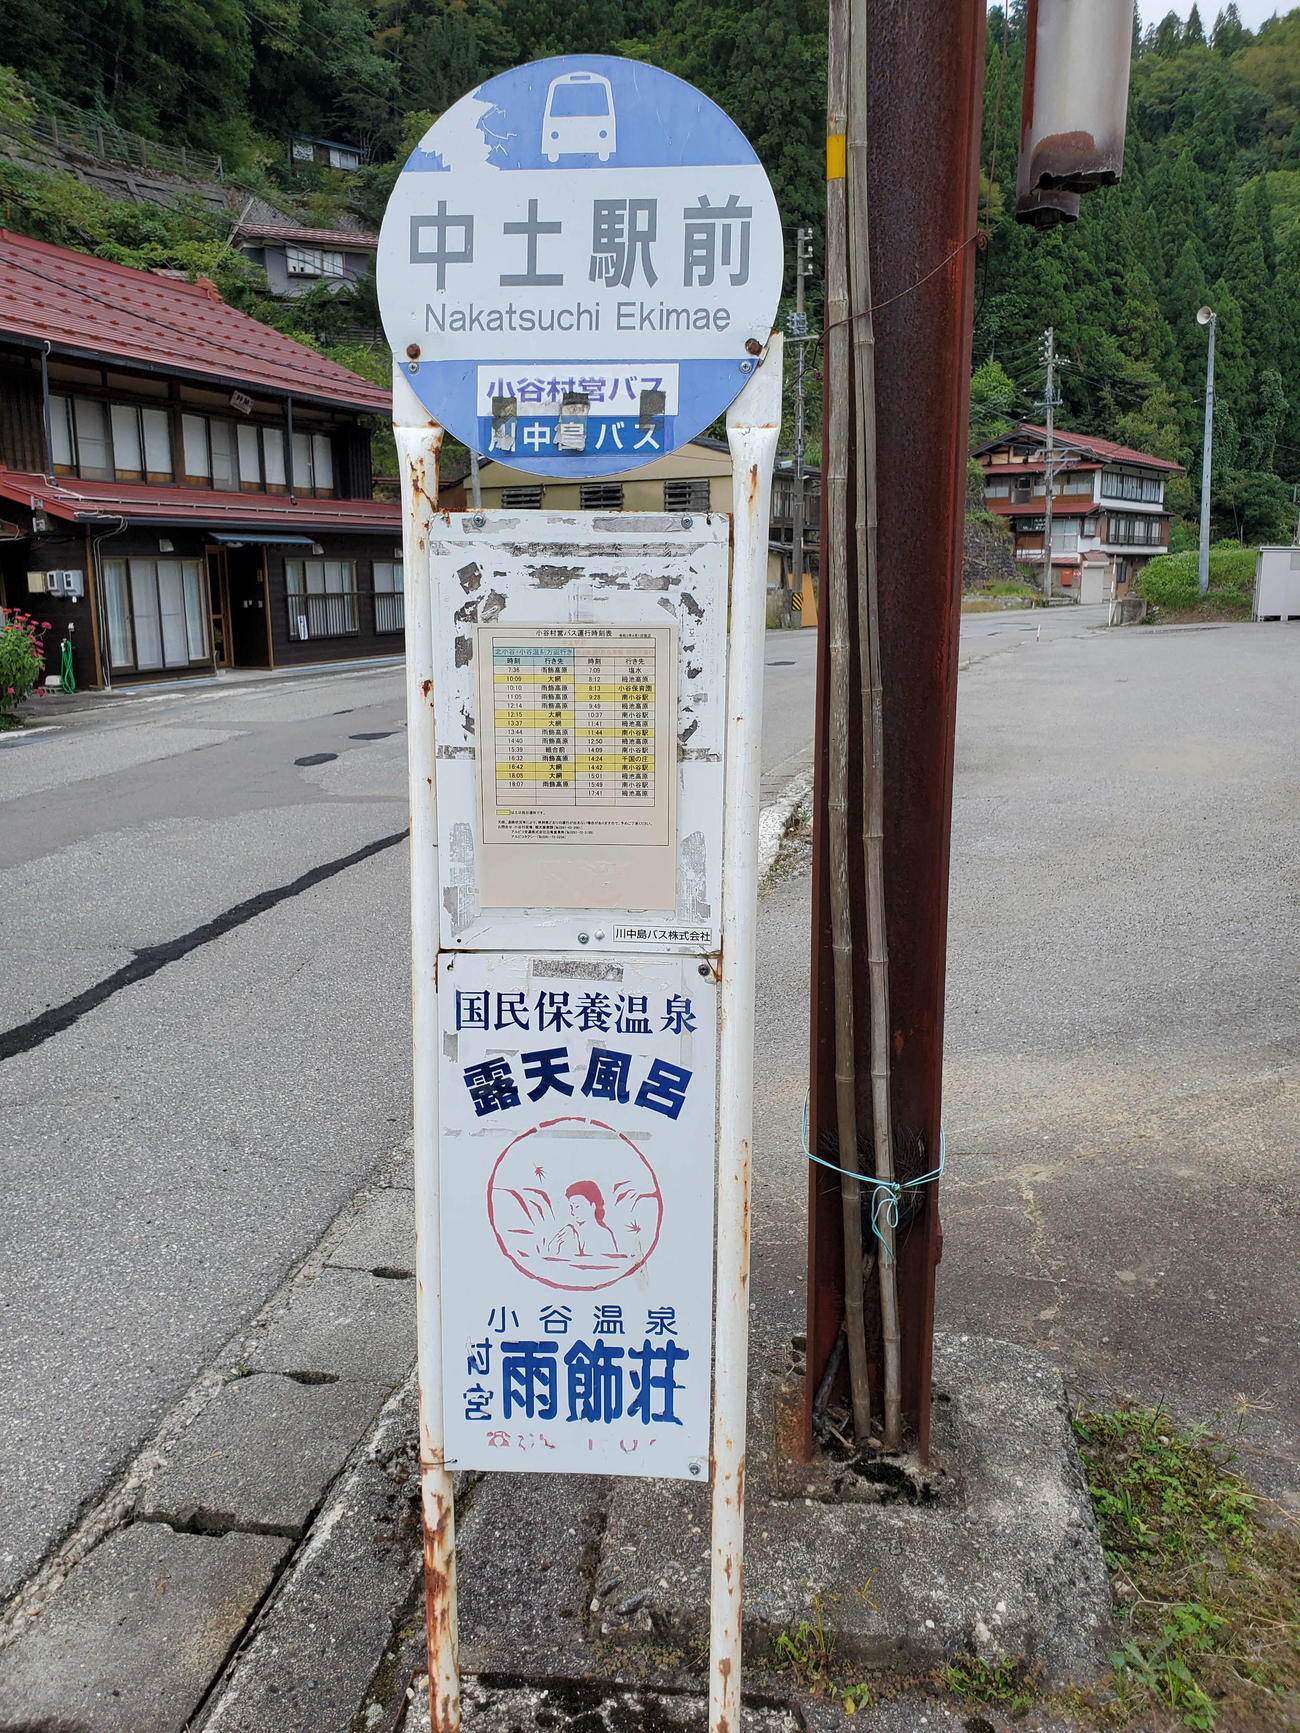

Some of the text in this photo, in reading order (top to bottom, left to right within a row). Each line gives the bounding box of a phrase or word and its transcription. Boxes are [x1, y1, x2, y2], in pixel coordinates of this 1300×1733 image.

[409, 194, 753, 292] 中土駅前
[425, 302, 731, 333] Nakatsuchi Ekimae
[615, 928, 711, 942] 川中島バス株式会社
[455, 989, 698, 1035] 国民保養温泉
[463, 1046, 693, 1121] 露天風呂
[487, 1304, 678, 1336] 小谷温泉
[500, 1338, 690, 1425] 雨飾荘
